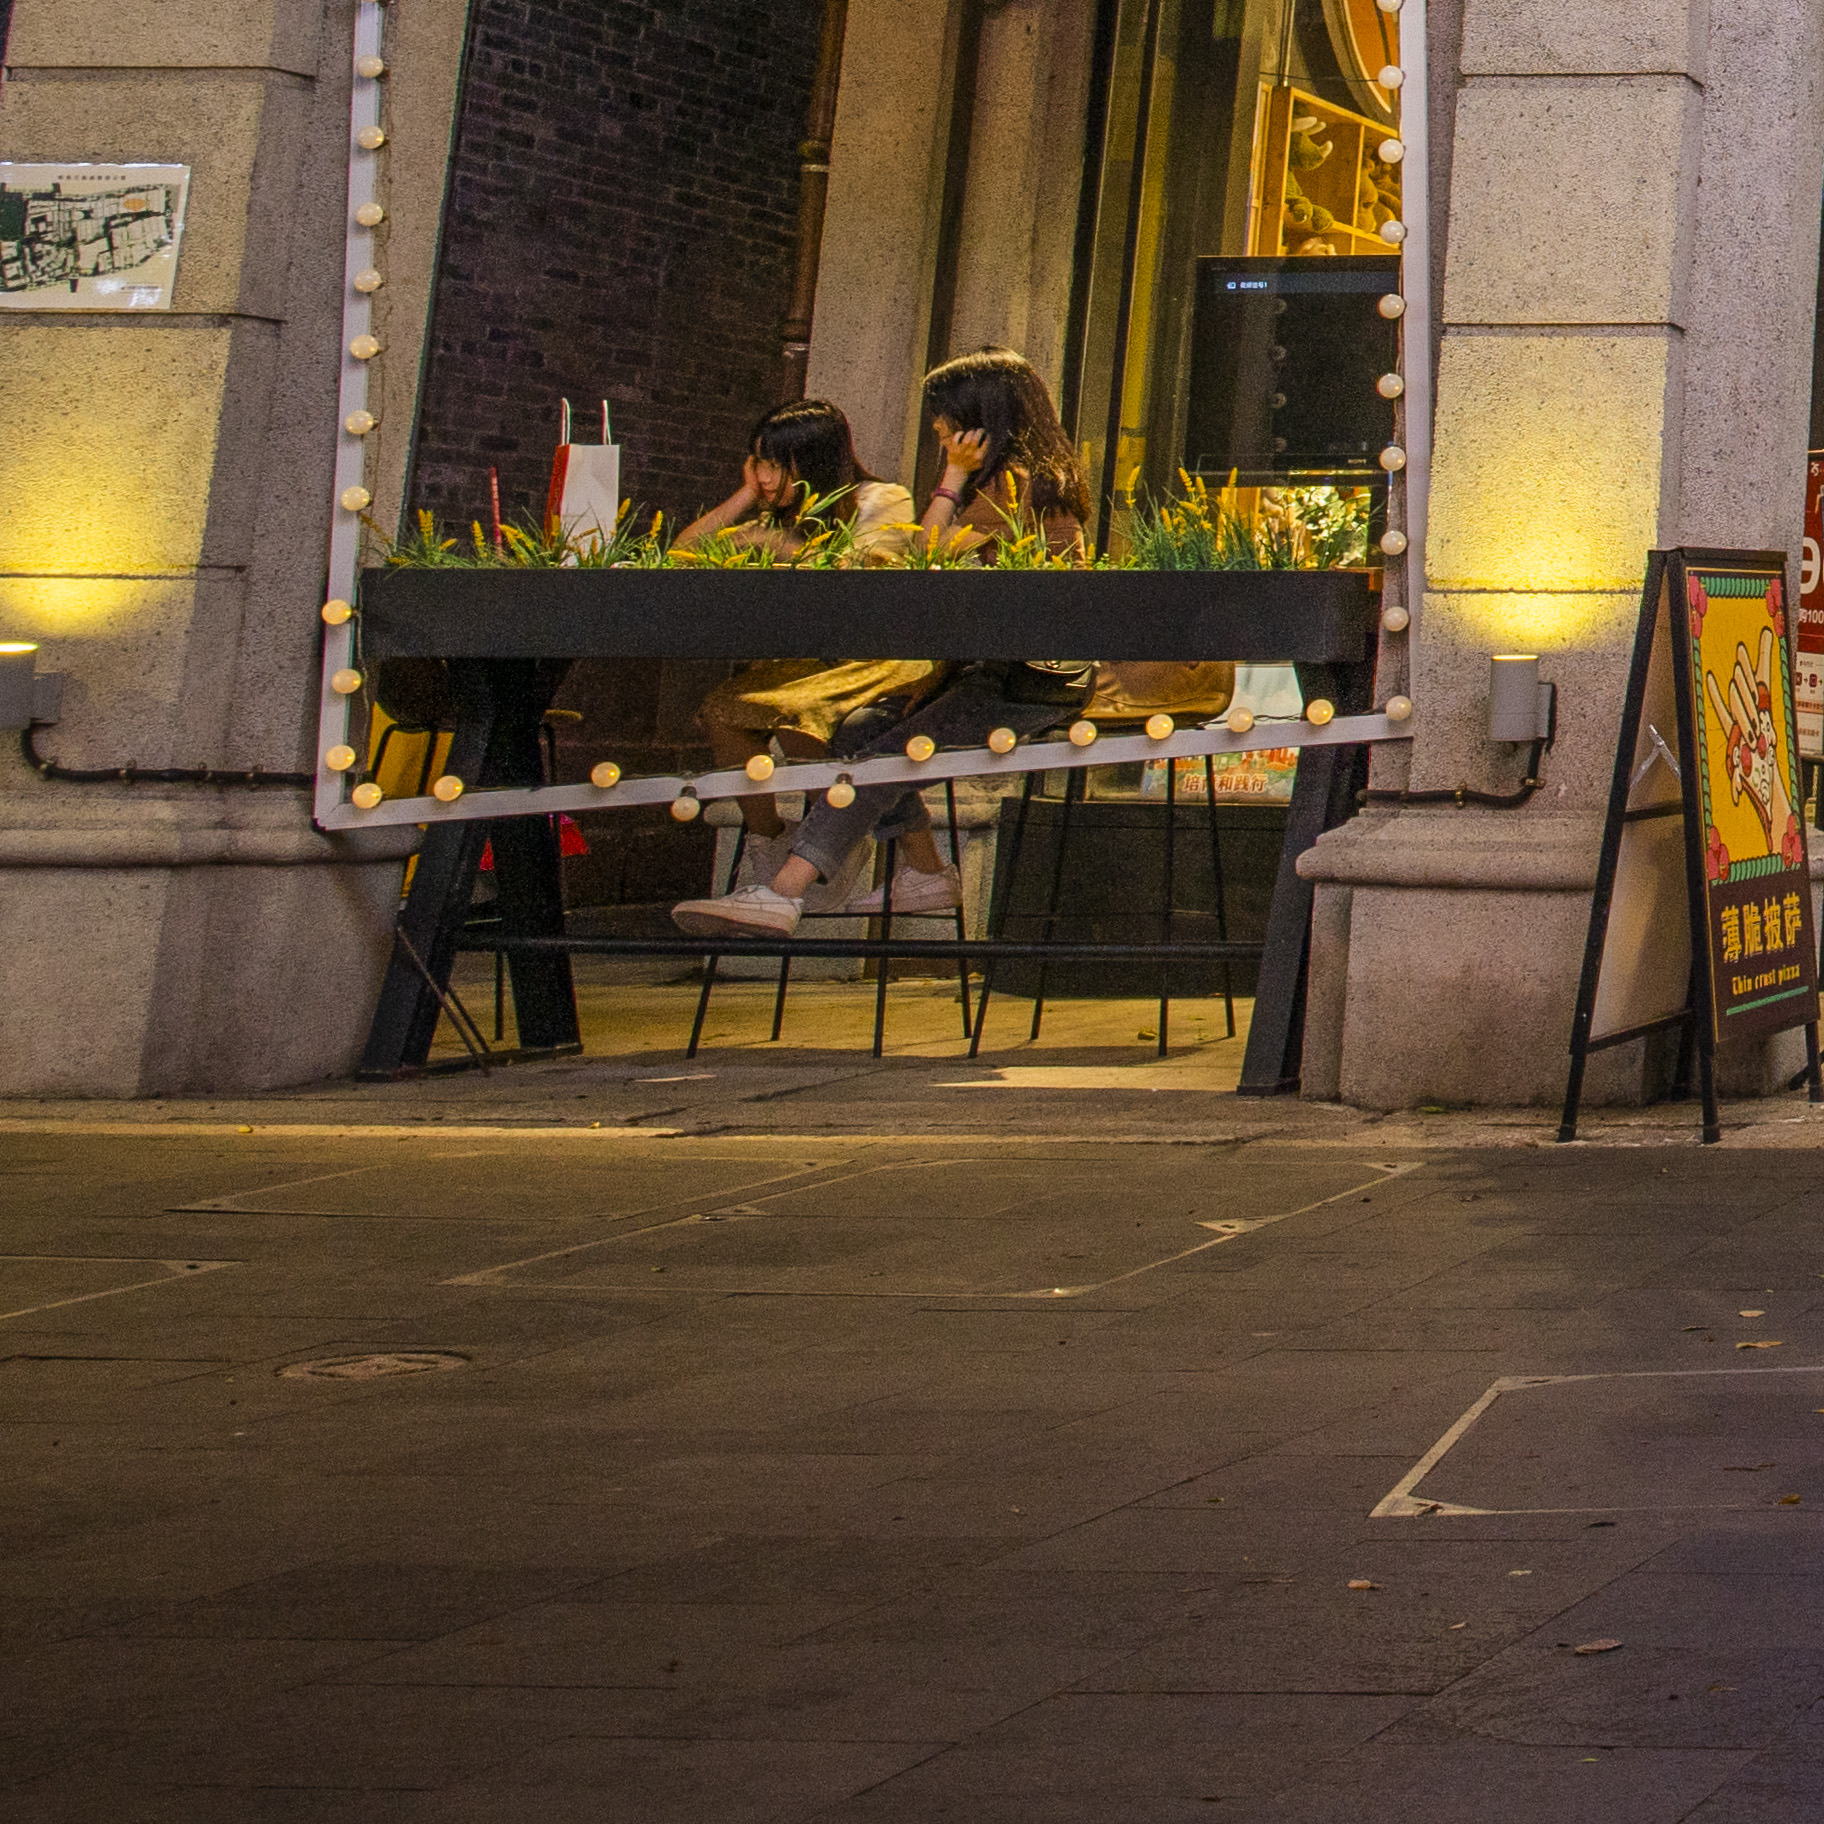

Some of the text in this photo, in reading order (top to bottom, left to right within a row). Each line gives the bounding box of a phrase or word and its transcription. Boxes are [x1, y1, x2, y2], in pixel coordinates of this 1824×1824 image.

[1720, 891, 1803, 964] 薄脆披萨
[1777, 964, 1801, 986] pizza
